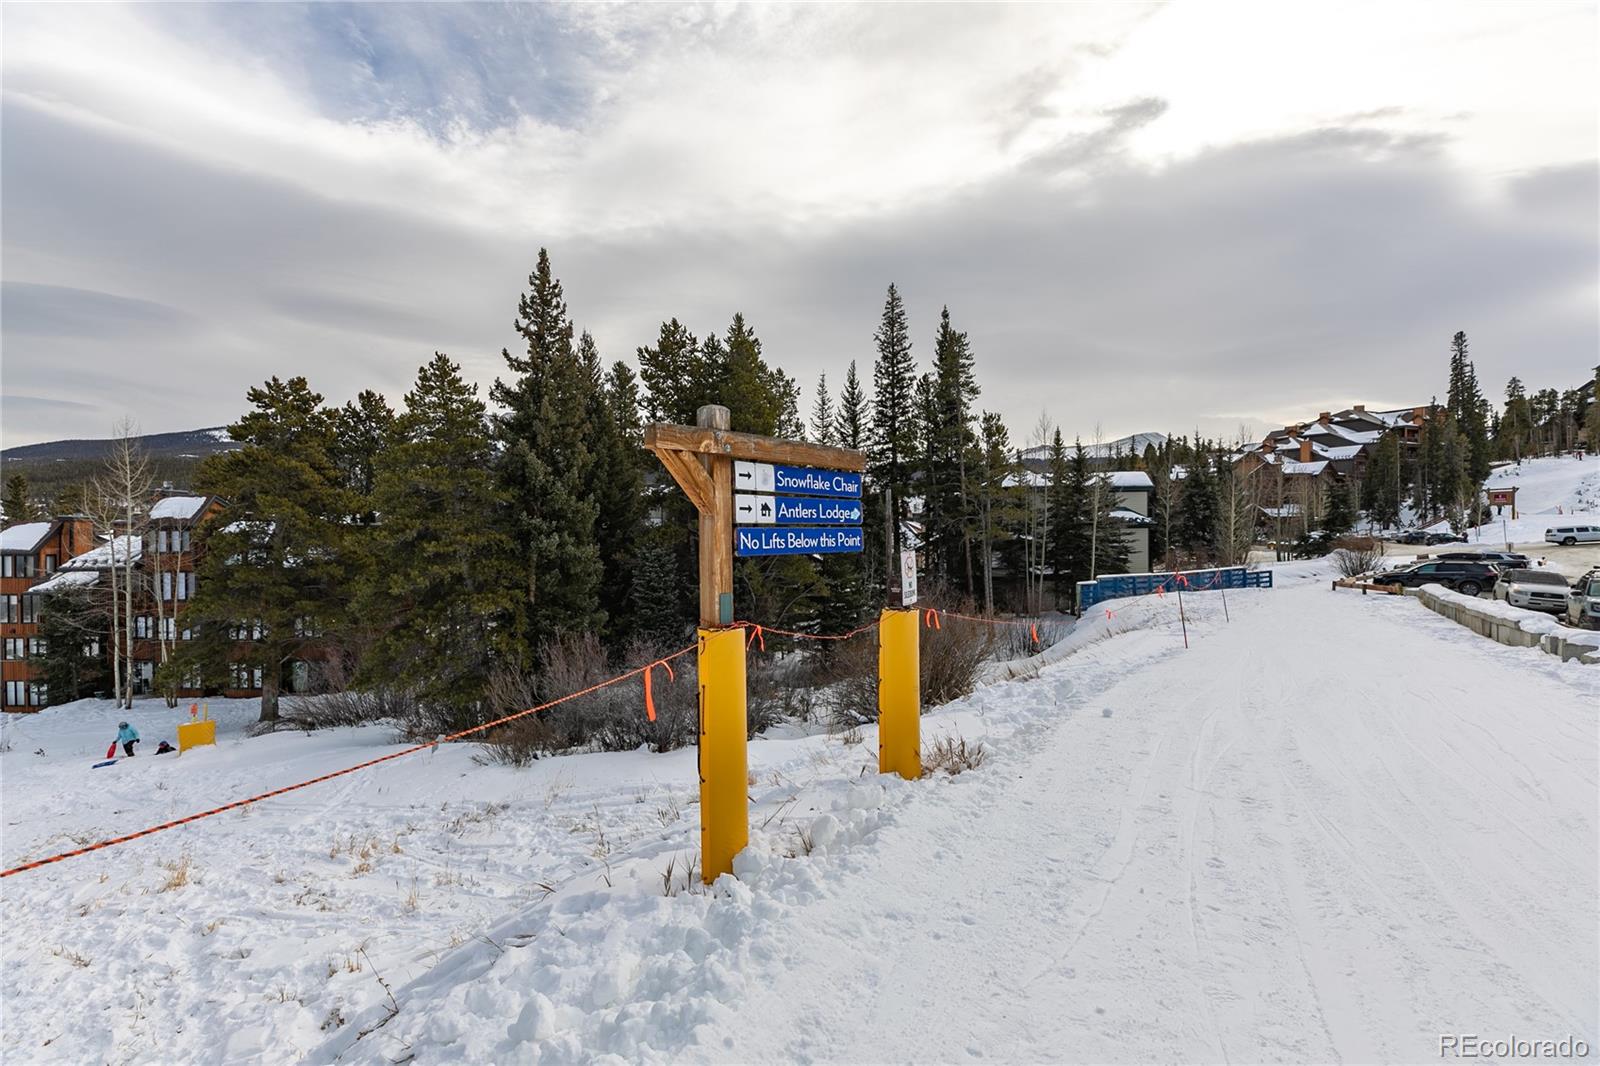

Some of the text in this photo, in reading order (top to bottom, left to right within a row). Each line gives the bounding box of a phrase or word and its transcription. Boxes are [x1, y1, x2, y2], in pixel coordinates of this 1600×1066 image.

[777, 471, 859, 493] Snowflake Chair
[778, 502, 851, 523] Antlers Lodge
[740, 532, 861, 550] No Lifts Below this Point
